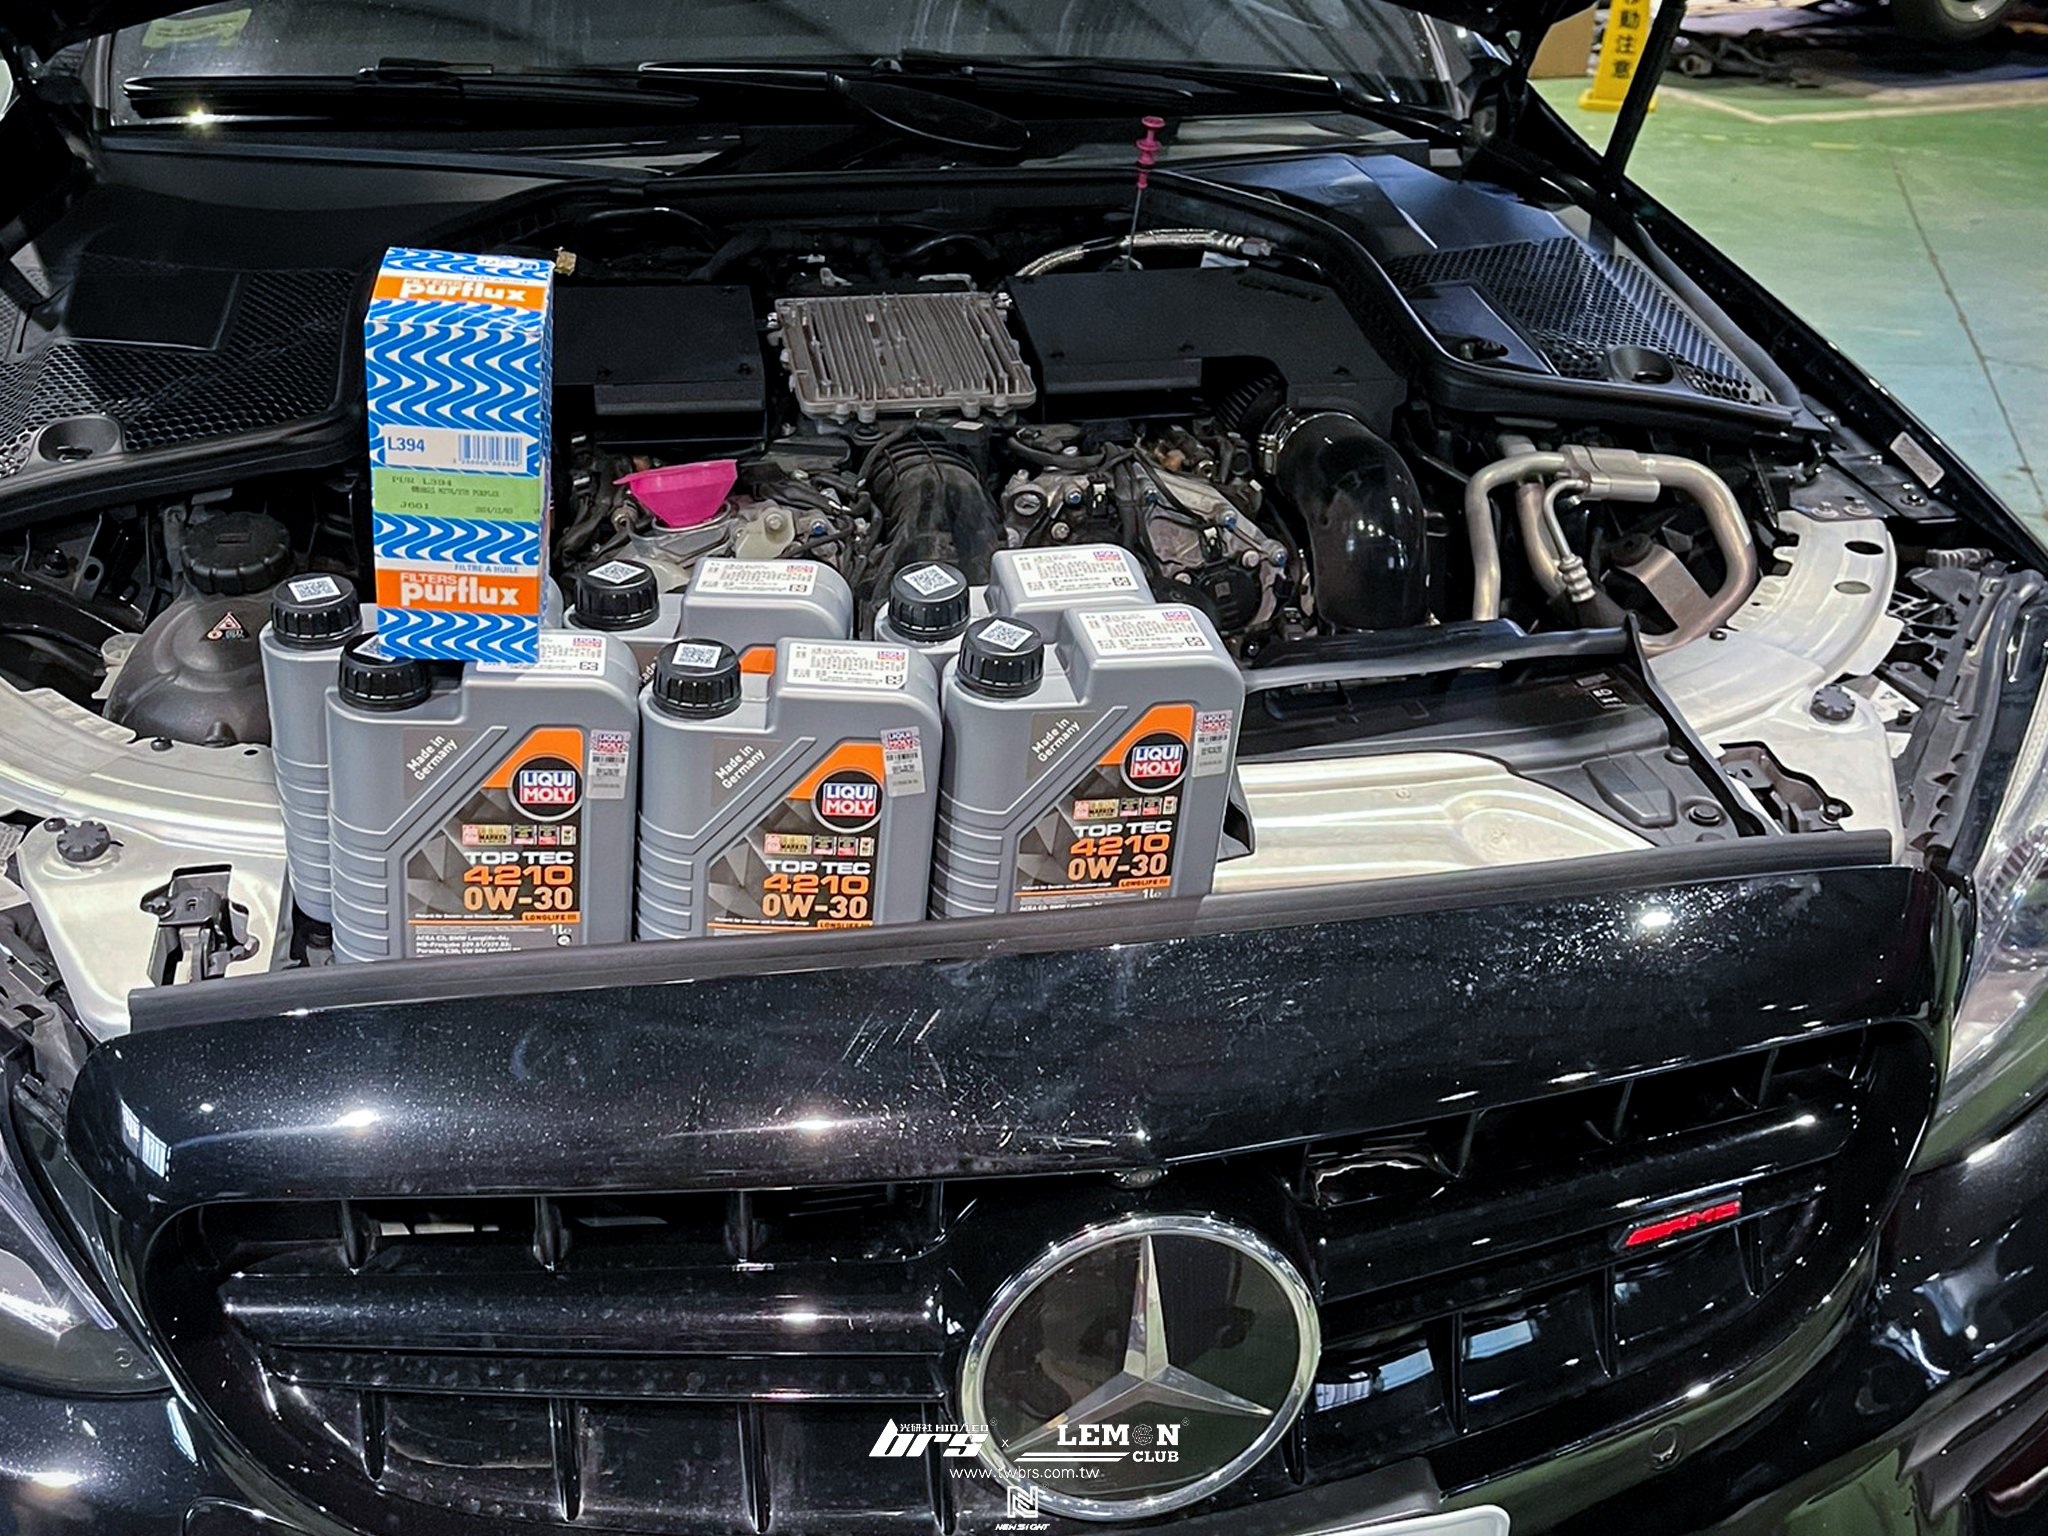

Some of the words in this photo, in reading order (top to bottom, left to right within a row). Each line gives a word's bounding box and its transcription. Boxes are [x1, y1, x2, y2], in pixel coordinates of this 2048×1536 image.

[399, 280, 527, 302] purflux
[388, 436, 425, 452] L394
[400, 572, 458, 584] FILTERS
[455, 564, 485, 573] FILTRE
[494, 566, 518, 574] HUILE
[401, 576, 520, 606] purflux
[1031, 727, 1059, 754] Made
[1053, 718, 1070, 735] in
[1037, 722, 1081, 763] Germany
[406, 743, 436, 772] Made
[430, 735, 446, 748] in
[414, 739, 458, 780] Germany
[714, 752, 746, 781] Made
[738, 745, 754, 760] in
[1134, 746, 1182, 763] LIQUI
[722, 749, 766, 790] Germany
[1131, 760, 1181, 777] MOLY
[523, 772, 572, 787] LIQUI
[523, 787, 573, 802] MOLY
[826, 785, 874, 800] LIQUI
[825, 800, 875, 815] MOLY
[1074, 823, 1124, 837] TOP
[1126, 820, 1172, 834] TEC
[1070, 834, 1170, 856] 4210
[466, 851, 519, 865] TOP
[522, 851, 574, 865] TEC
[768, 860, 819, 873] TOP
[822, 861, 871, 874] TEC
[1067, 855, 1168, 881] 0W-30
[463, 865, 573, 886] 4210
[763, 874, 870, 894] 4210
[1120, 880, 1158, 888] LONGLIFE
[463, 886, 573, 911] 0W-30
[762, 893, 868, 919] 0W-30
